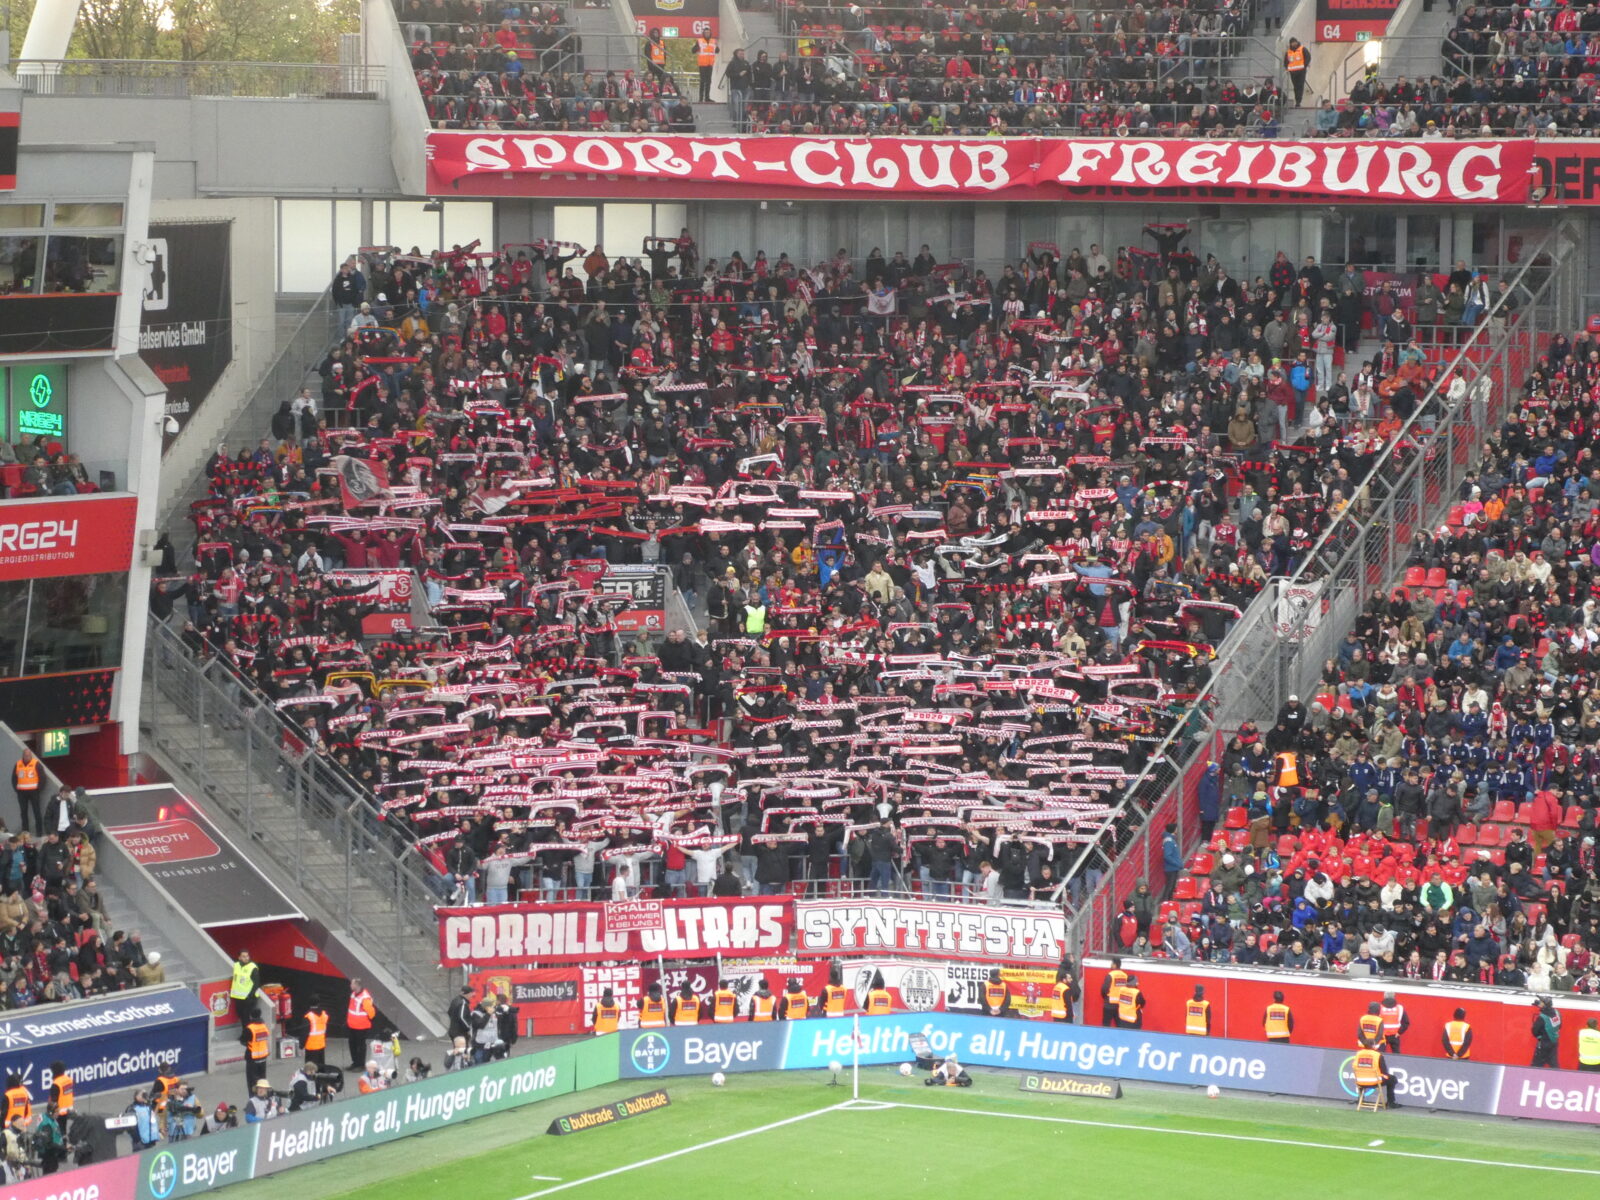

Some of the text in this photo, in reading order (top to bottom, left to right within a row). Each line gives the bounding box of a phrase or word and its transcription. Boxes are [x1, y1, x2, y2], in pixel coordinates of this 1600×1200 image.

[1323, 25, 1340, 39] G4
[464, 137, 1503, 201] SPORT-CLUB FREIBURG
[181, 321, 206, 348] GmbH
[608, 903, 660, 914] KHALID
[608, 912, 661, 922] FÜR IMMER
[634, 919, 654, 927] UNS
[804, 907, 1062, 959] SYNTHESIA
[583, 967, 640, 982] FUSS
[516, 983, 574, 999] Knaddly's
[24, 1003, 174, 1038] BarmeniaGothaer
[685, 1038, 763, 1068] Bayer
[812, 1025, 1266, 1080] Health for all, Hunger for none
[1041, 1077, 1112, 1096] buXtrade
[1389, 1067, 1470, 1105] Bayer
[268, 1064, 556, 1162] Health for all, Hunger for none
[570, 1092, 668, 1130] buXtrade buXtrade
[183, 1149, 238, 1186] Bayer
